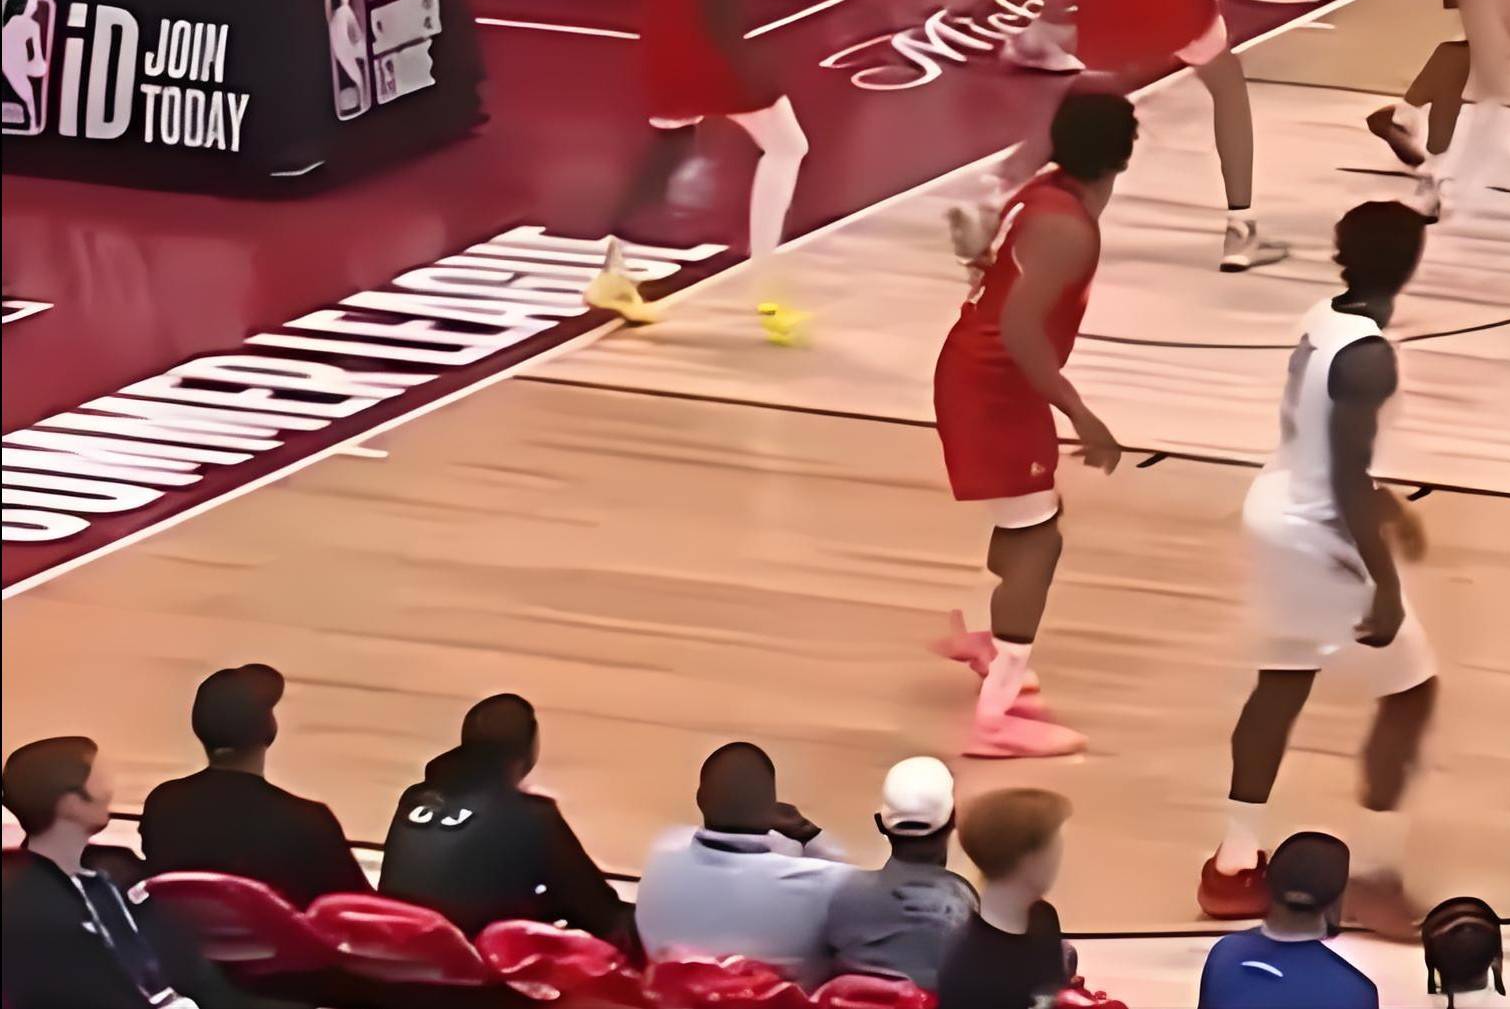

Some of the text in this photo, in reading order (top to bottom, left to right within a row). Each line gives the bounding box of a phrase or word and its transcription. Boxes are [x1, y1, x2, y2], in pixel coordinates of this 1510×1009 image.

[58, 2, 139, 140] iD
[144, 18, 229, 83] JOIN
[140, 83, 250, 152] TODAY
